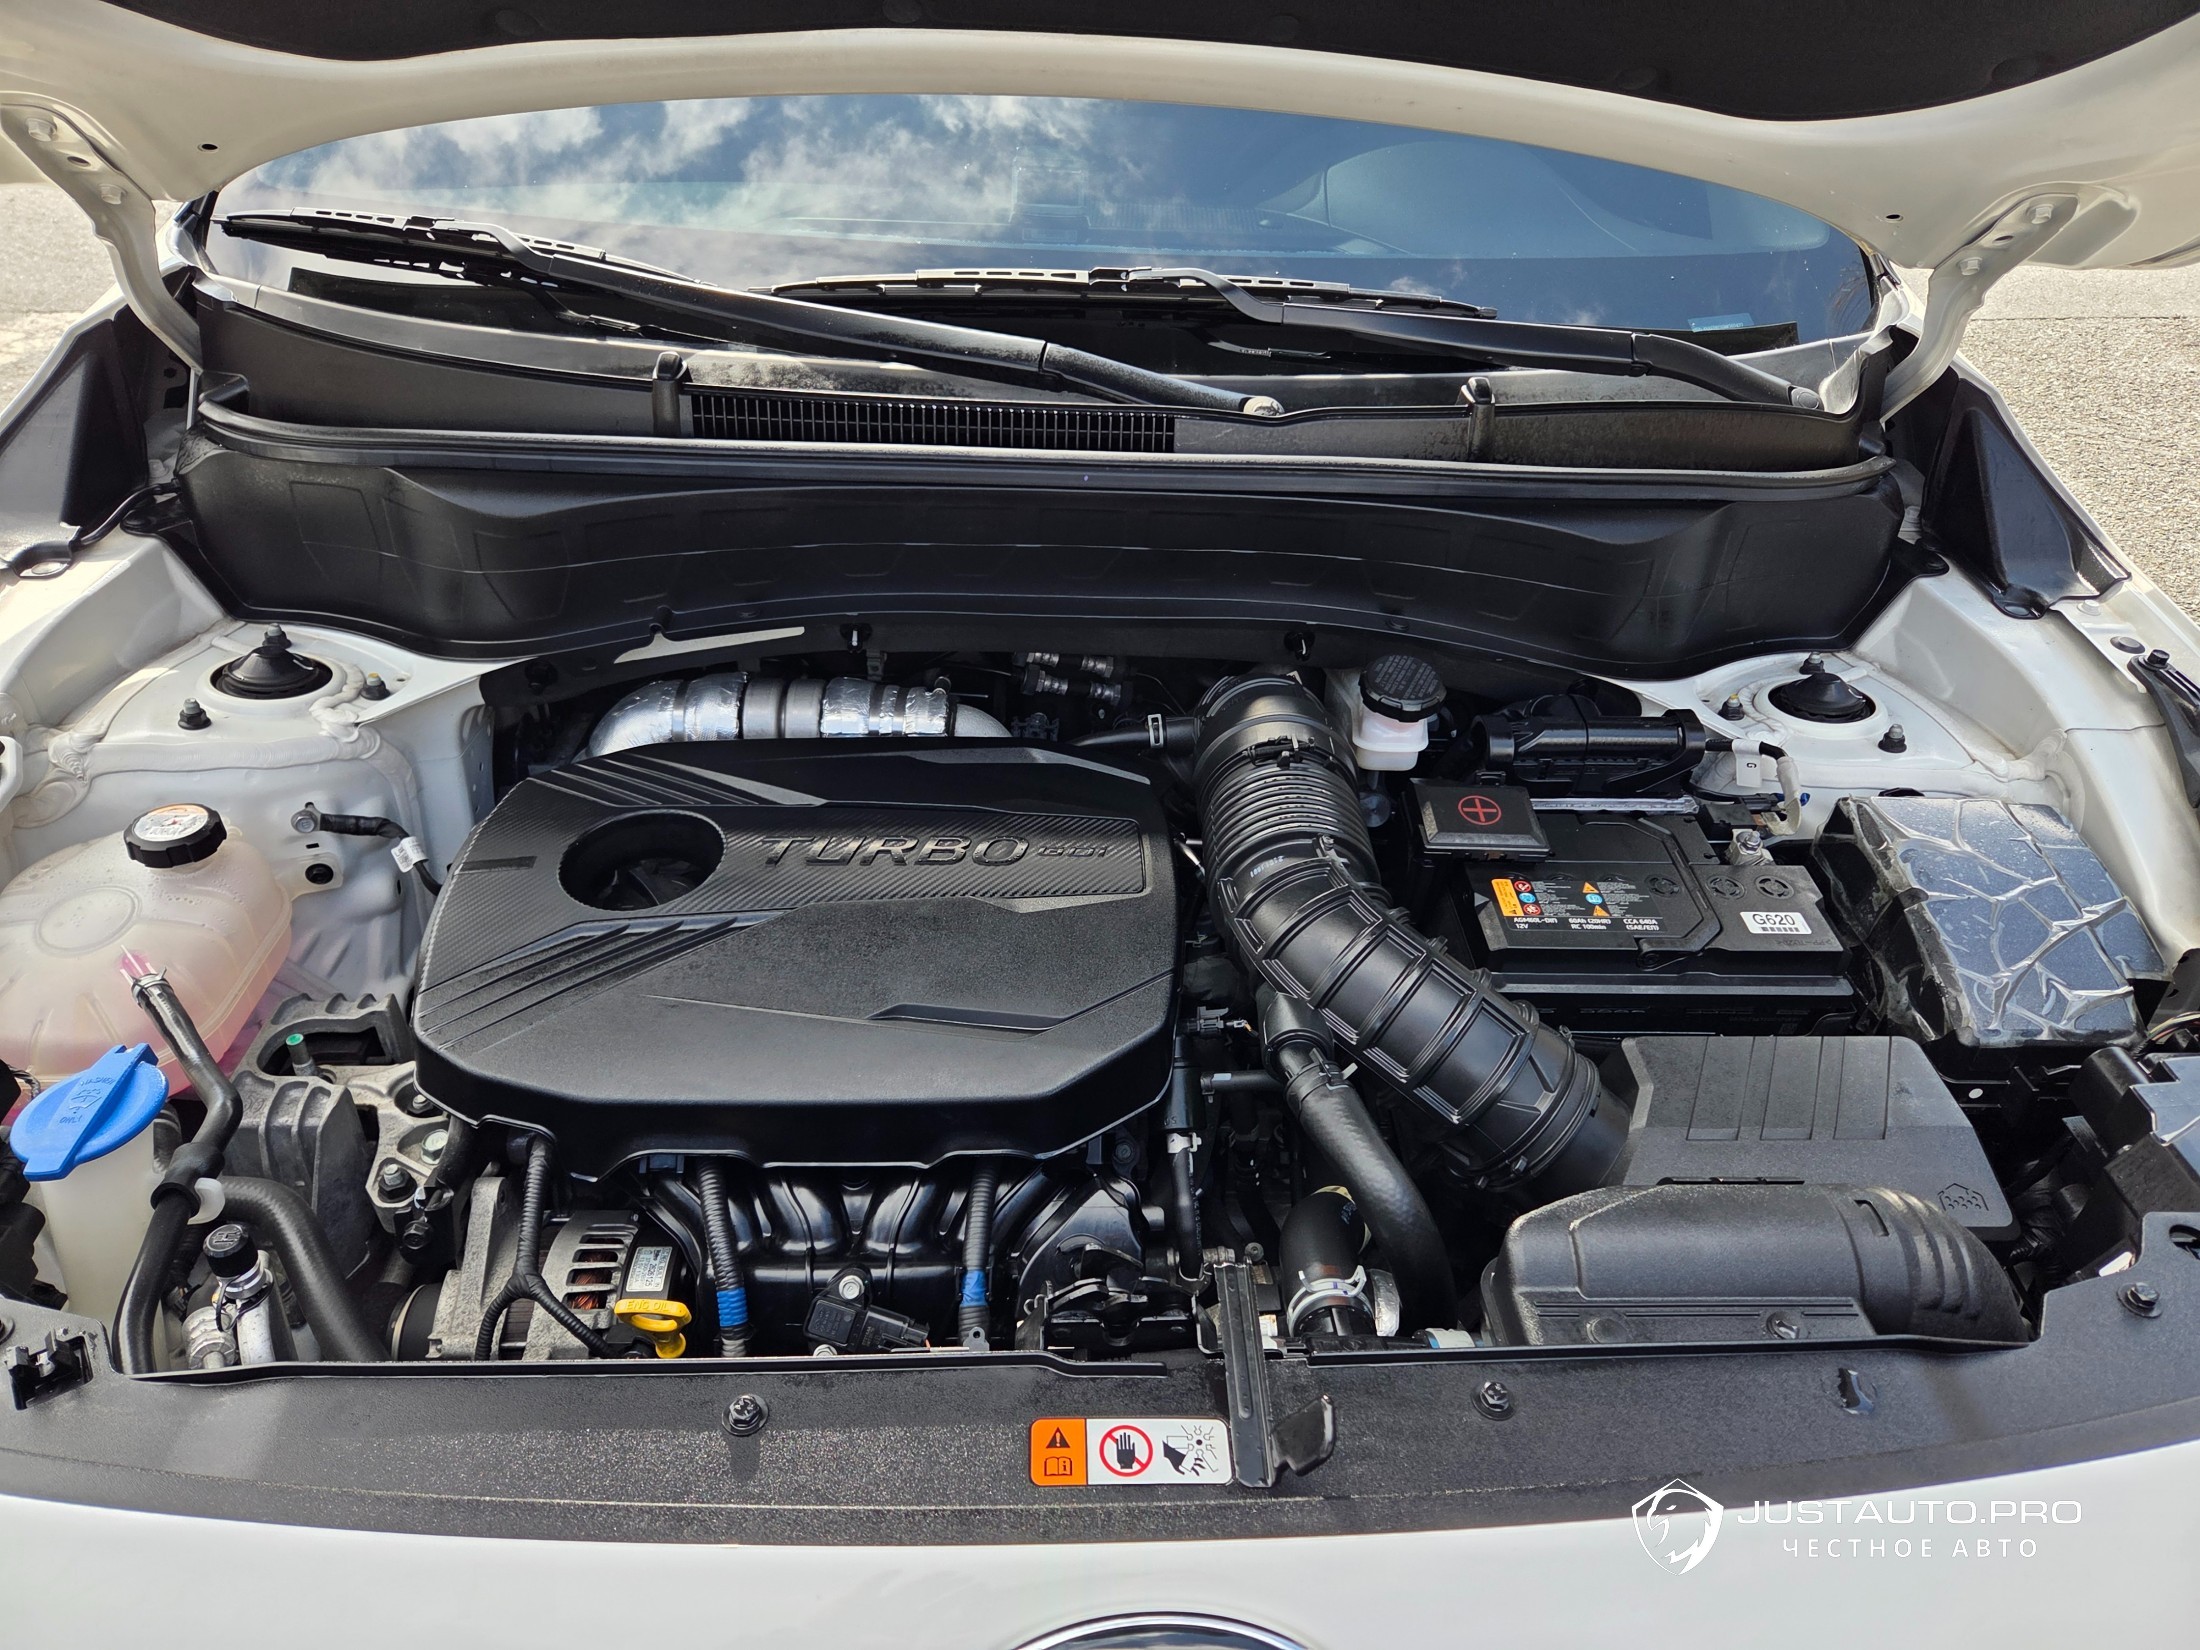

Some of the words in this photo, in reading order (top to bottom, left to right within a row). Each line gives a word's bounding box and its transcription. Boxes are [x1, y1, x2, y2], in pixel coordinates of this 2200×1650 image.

[764, 835, 1030, 867] TURBO
[1752, 913, 1796, 926] G620
[59, 1114, 83, 1124] ONLY
[627, 1300, 650, 1311] ENG
[653, 1301, 669, 1313] OIL
